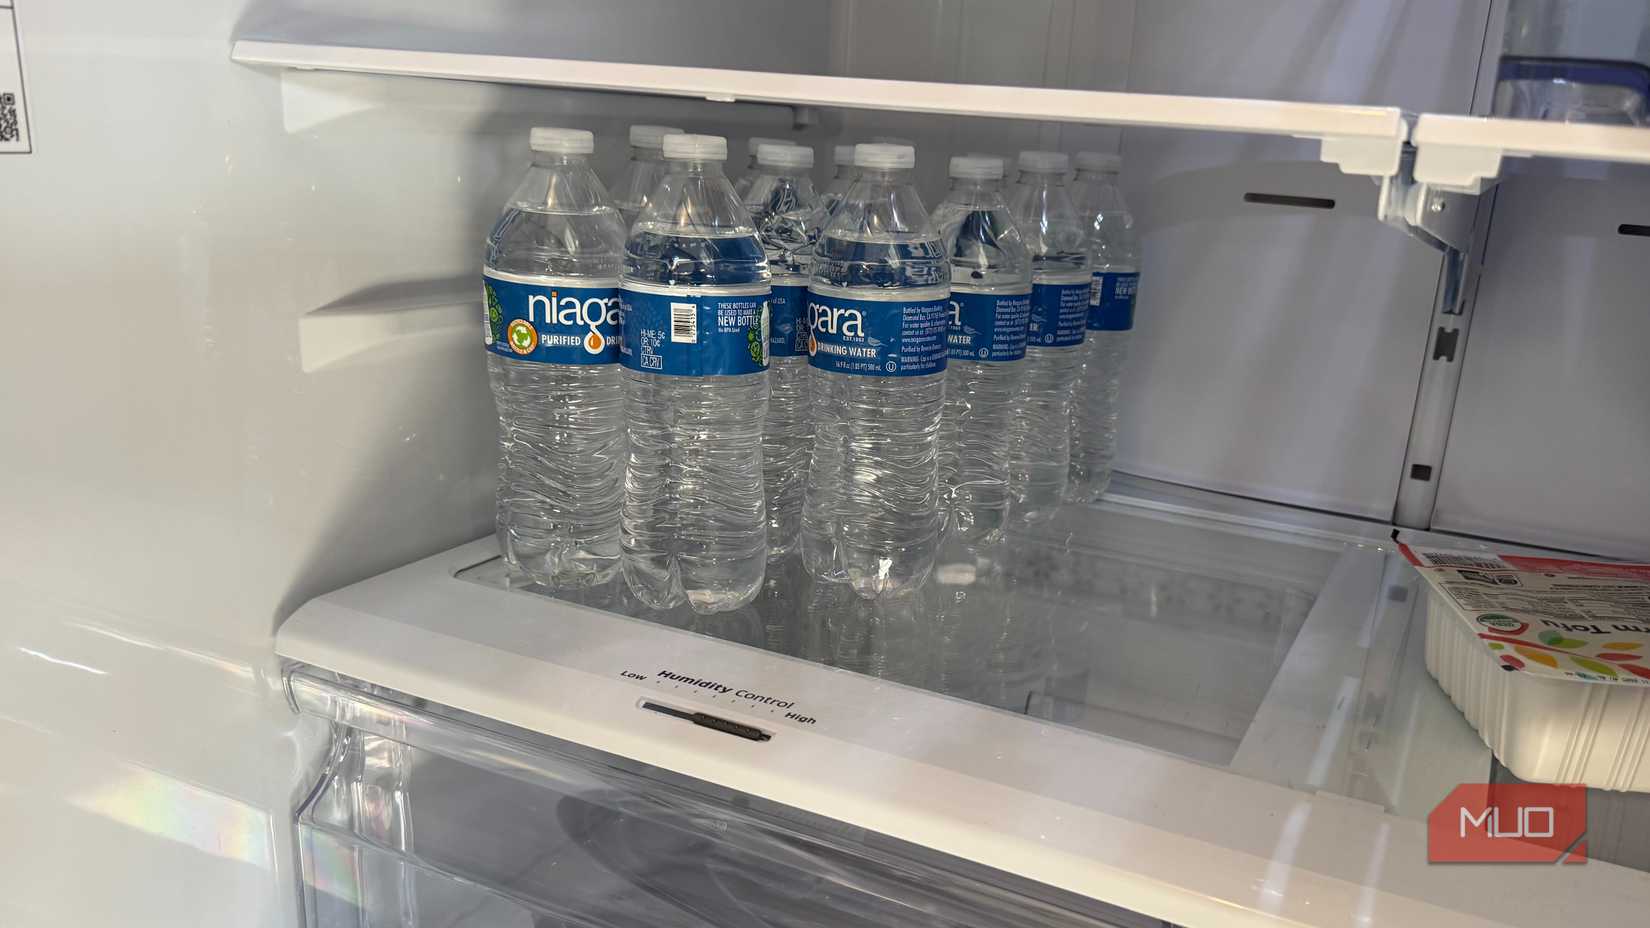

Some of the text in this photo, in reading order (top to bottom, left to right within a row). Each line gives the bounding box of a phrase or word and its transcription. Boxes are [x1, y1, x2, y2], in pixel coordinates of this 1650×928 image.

[718, 316, 736, 326] NEW
[542, 334, 580, 346] PURIFIED
[818, 342, 877, 358] DRINKING WATER
[1541, 620, 1612, 634] Tofu
[620, 670, 647, 681] Low
[657, 669, 794, 709] Humidity Control
[784, 712, 817, 725] High
